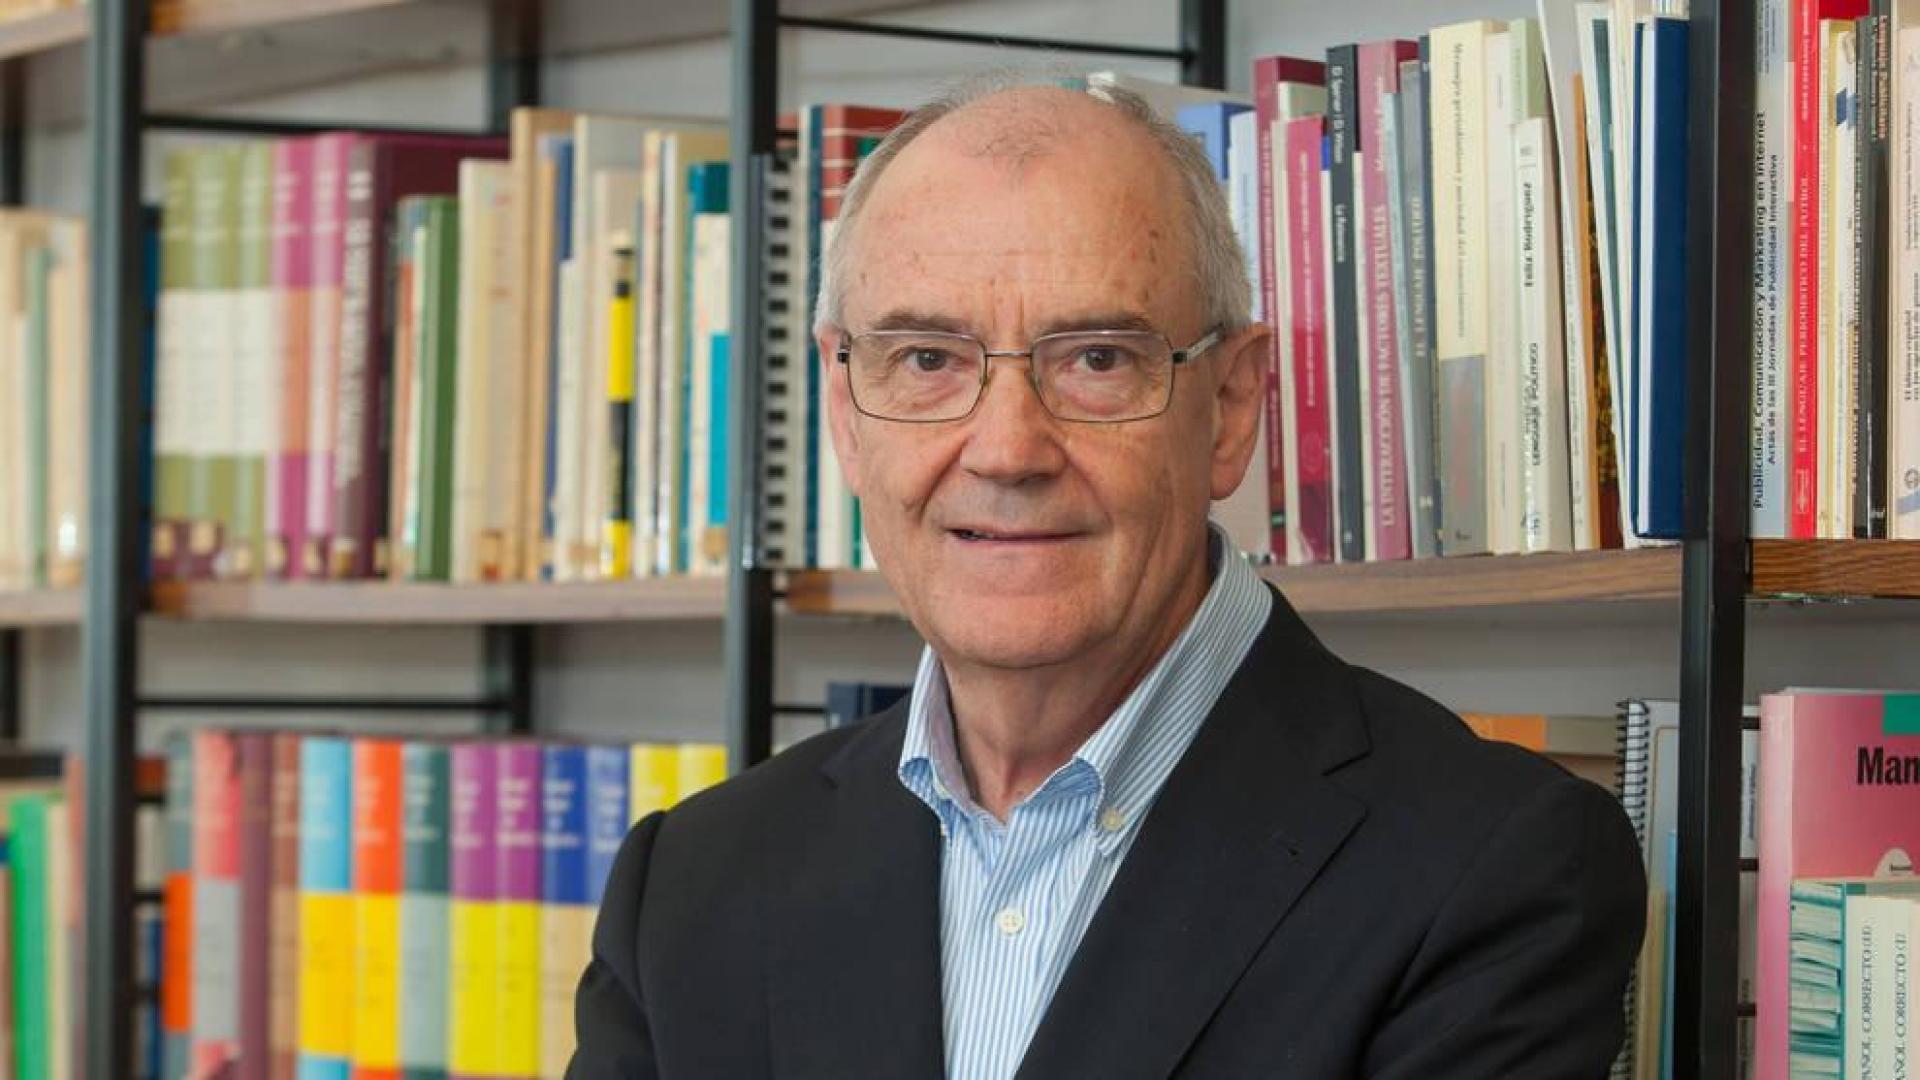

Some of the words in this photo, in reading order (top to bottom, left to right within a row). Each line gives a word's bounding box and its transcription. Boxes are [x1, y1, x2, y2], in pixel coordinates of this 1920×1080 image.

[1754, 111, 1766, 177] Internet
[1756, 181, 1766, 201] en
[1767, 154, 1777, 222] Interactiva
[1754, 206, 1767, 288] Marketing
[1767, 226, 1777, 291] Publicidad
[1767, 295, 1777, 311] de
[1752, 307, 1765, 418] Comunicación
[1767, 315, 1776, 371] Jornadas
[1767, 374, 1776, 386] III
[1767, 389, 1776, 408] las
[1798, 360, 1808, 432] LENGUAJE
[1767, 411, 1776, 427] de
[1767, 430, 1776, 465] Actas
[1798, 435, 1808, 452] EL
[1752, 422, 1765, 509] Publicidad,
[1857, 745, 1920, 786] Man
[1860, 947, 1873, 1034] CORRECTO
[1893, 952, 1907, 1039] CORRECTO
